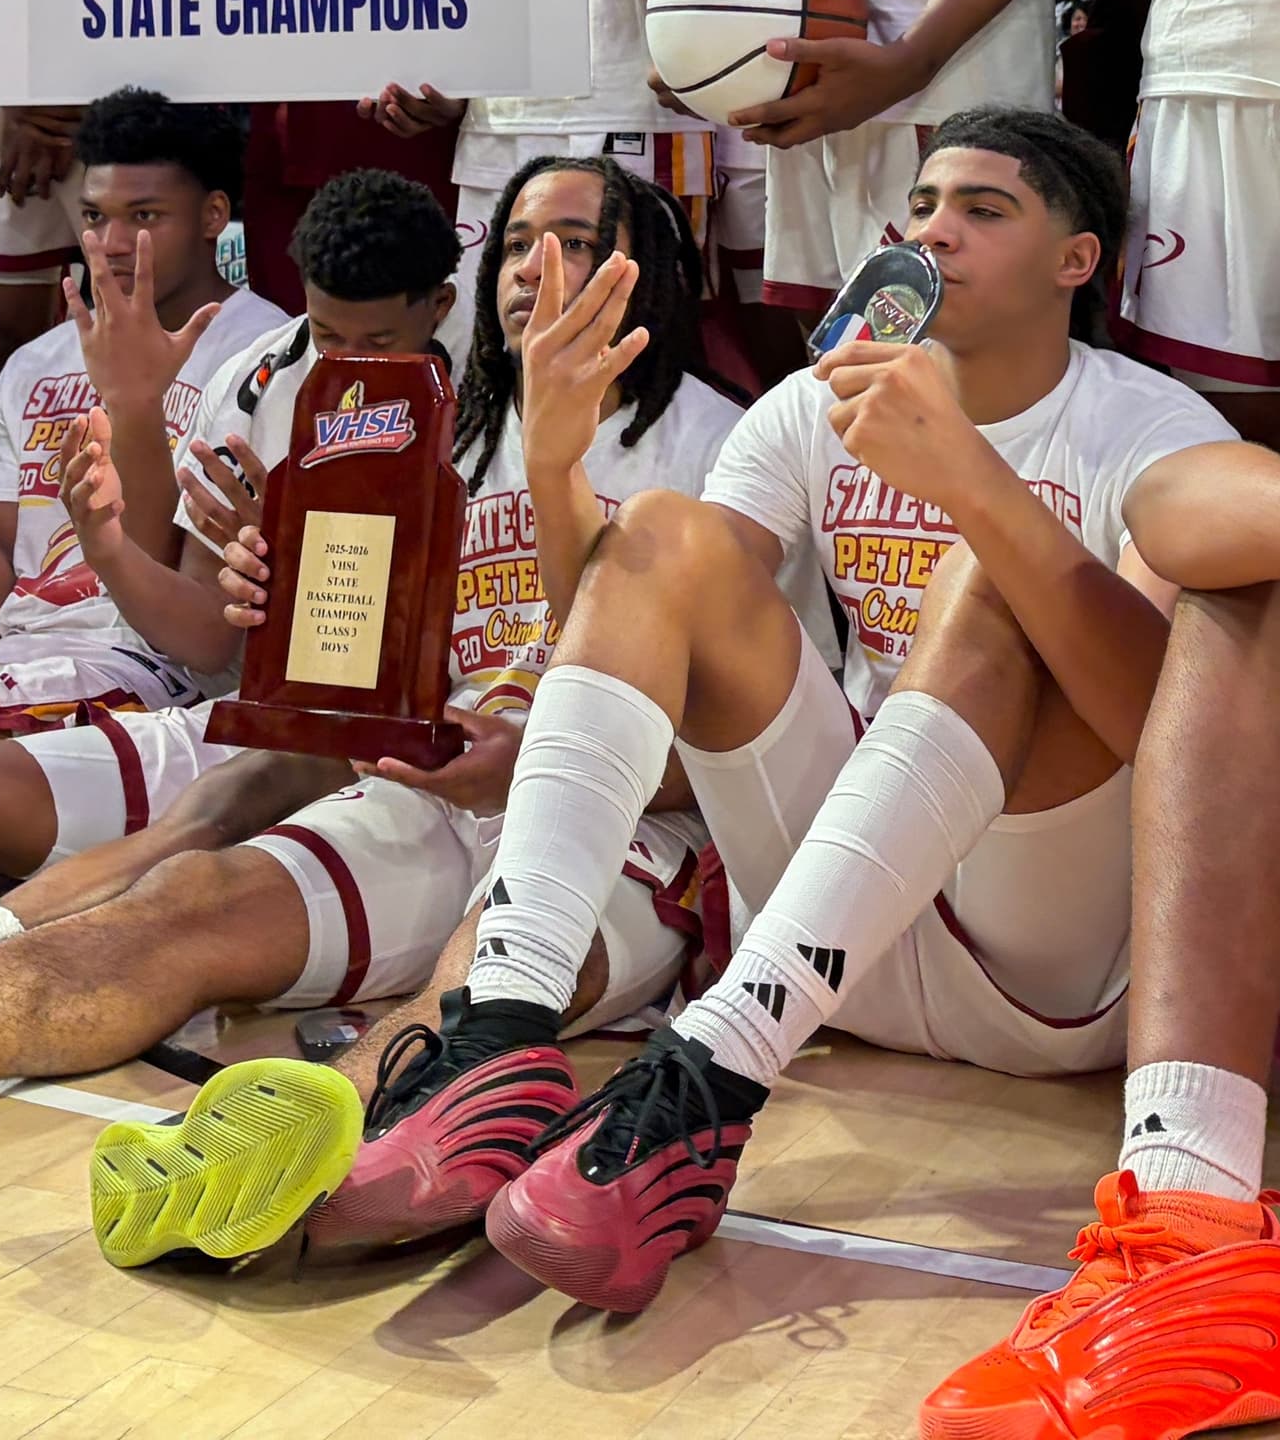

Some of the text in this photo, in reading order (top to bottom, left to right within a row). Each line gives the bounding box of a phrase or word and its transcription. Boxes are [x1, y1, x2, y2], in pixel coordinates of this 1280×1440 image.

[316, 403, 409, 447] VHSL
[331, 560, 359, 571] VHSL
[326, 576, 359, 588] STATE
[306, 591, 376, 606] BASKETBALL
[310, 608, 368, 621] CHAMPION
[316, 625, 358, 638] CLASS 3
[320, 641, 350, 653] BOYS
[458, 634, 482, 667] 20
